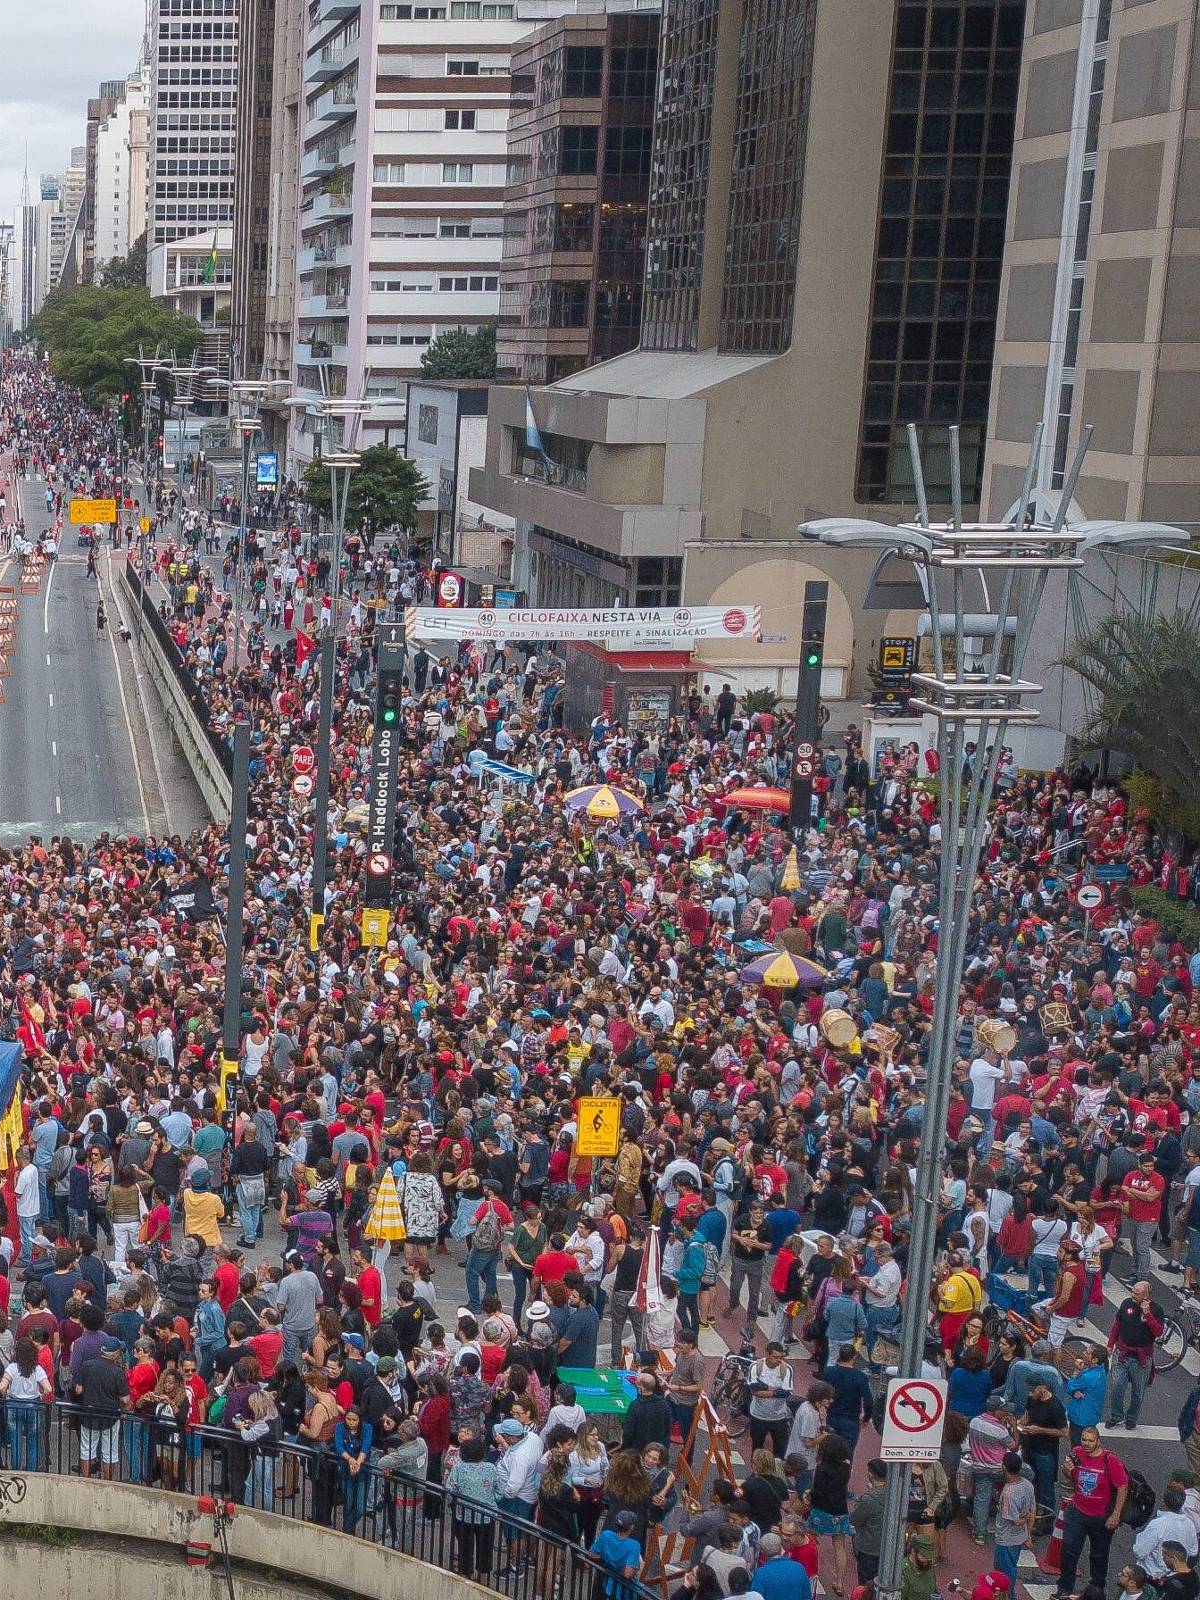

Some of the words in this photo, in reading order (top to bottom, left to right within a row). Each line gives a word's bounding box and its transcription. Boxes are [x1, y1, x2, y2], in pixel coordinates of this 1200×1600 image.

[480, 614, 493, 622] 40
[508, 612, 588, 623] CICLOFAIXA
[592, 611, 636, 623] NESTA
[639, 611, 662, 622] VIA
[675, 612, 689, 620] 40
[461, 630, 506, 638] DOMINGO
[509, 630, 526, 638] das
[530, 630, 540, 638] 7h
[559, 630, 575, 638] 16h
[587, 630, 631, 638] RESPEITE
[635, 629, 642, 638] A
[646, 627, 708, 638] SINALIZAÇÃO
[377, 730, 392, 767] Lobo
[293, 755, 314, 765] PARE
[373, 771, 390, 837] Haddock
[372, 838, 386, 853] R.
[885, 1449, 904, 1457] Dom.
